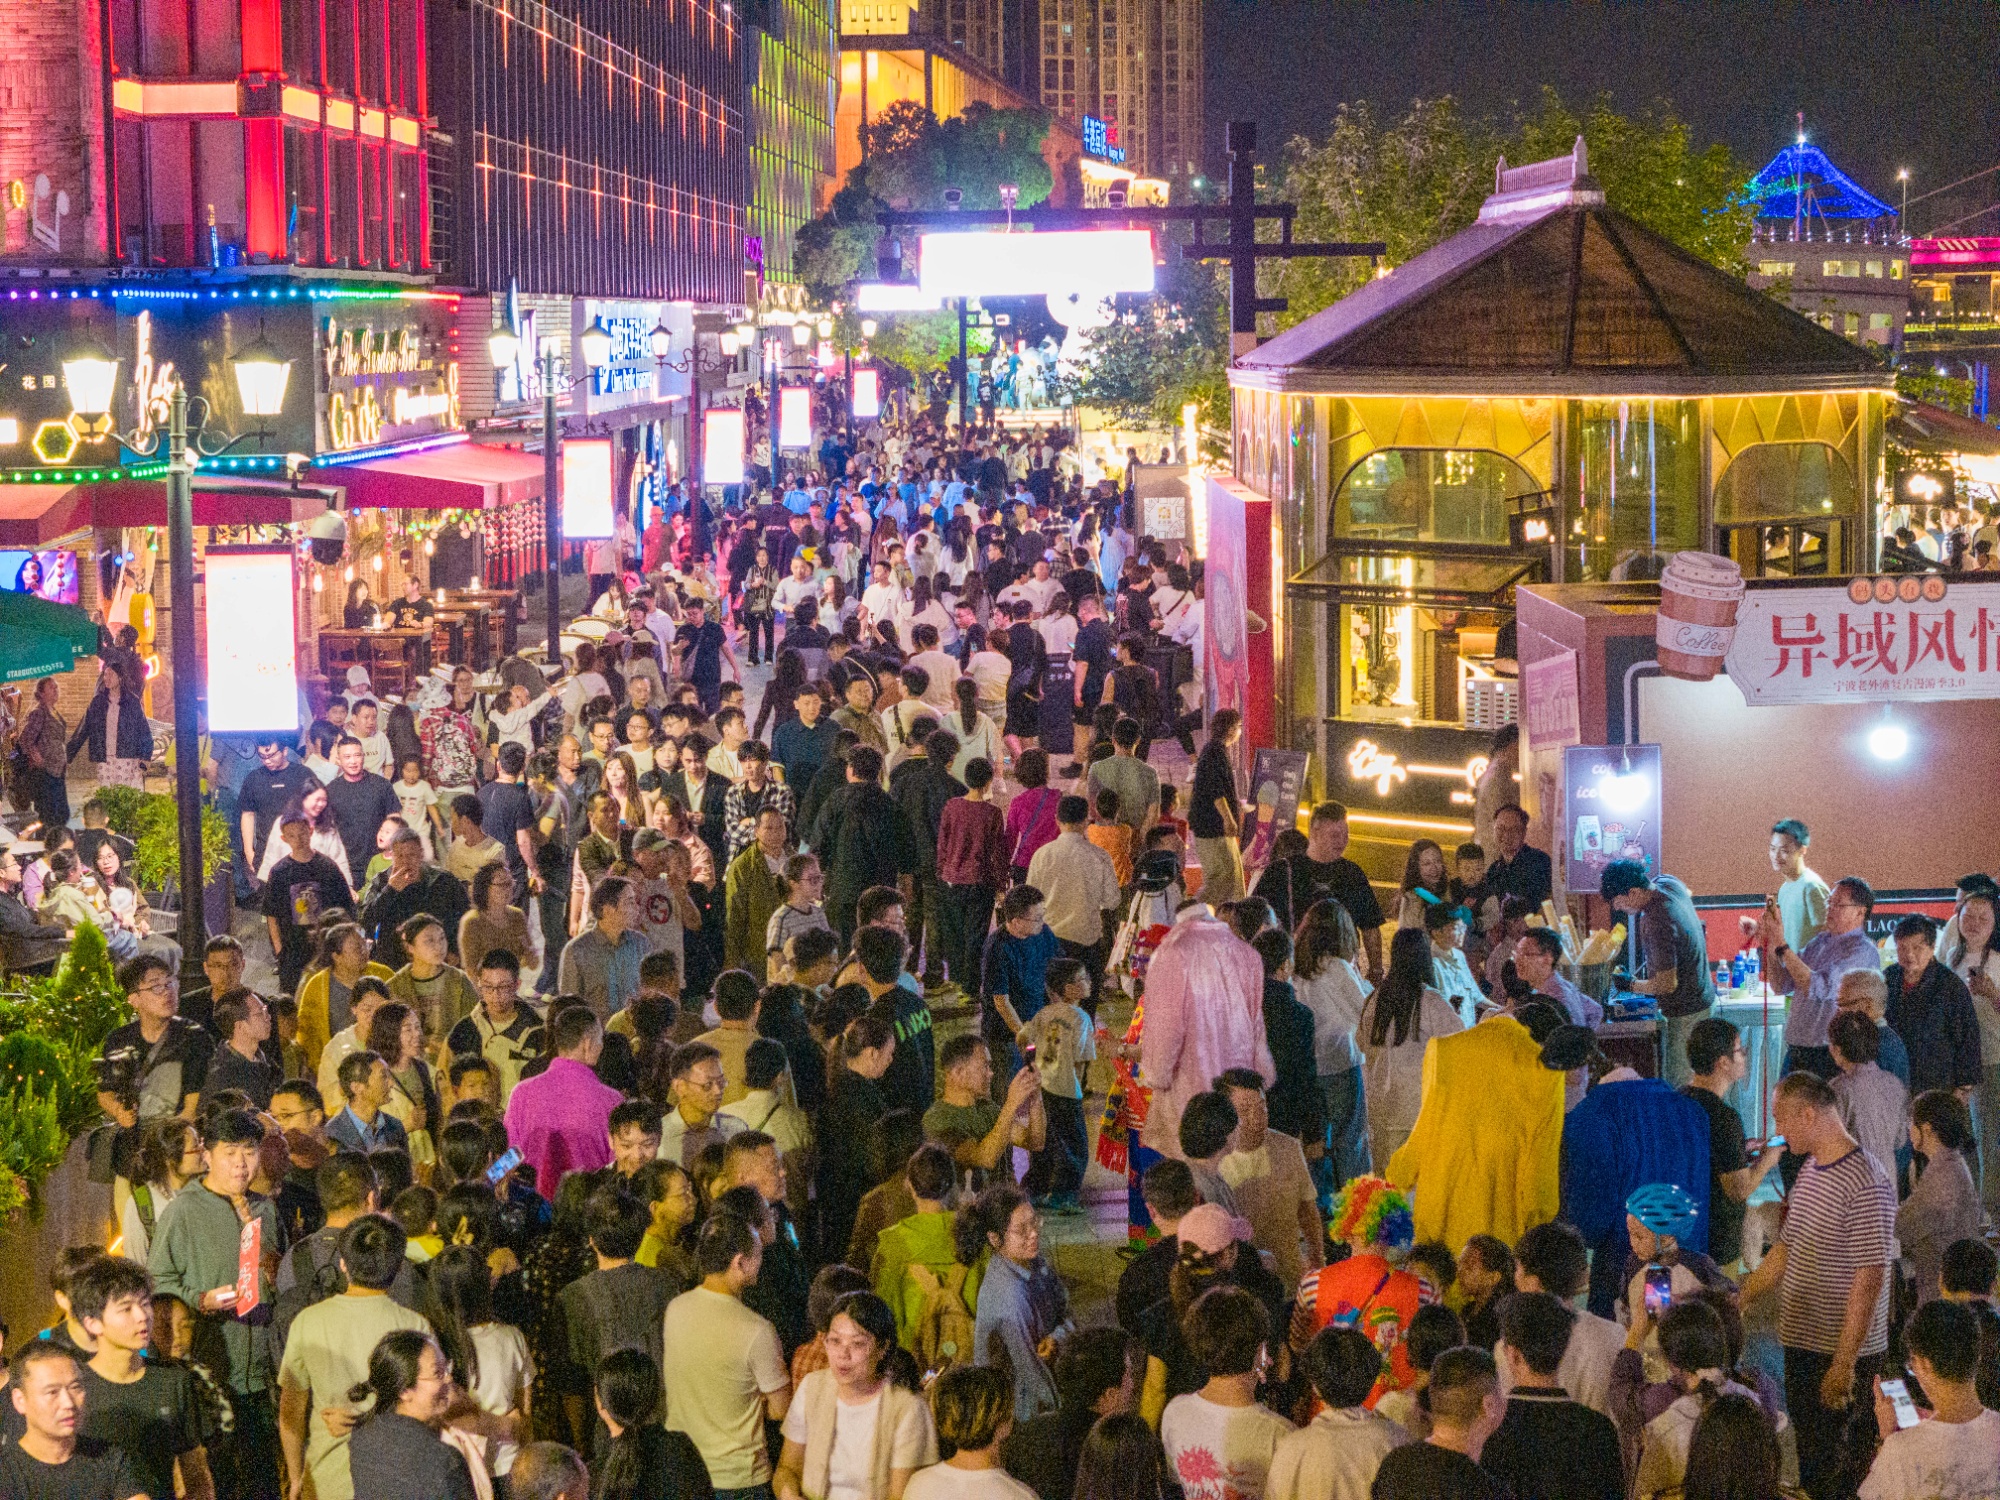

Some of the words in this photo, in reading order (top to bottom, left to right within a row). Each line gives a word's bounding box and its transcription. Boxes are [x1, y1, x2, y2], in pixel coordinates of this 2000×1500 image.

[340, 330, 360, 376] The
[361, 328, 398, 374] Garden
[398, 330, 420, 373] Bar
[1675, 626, 1726, 652] Coffee
[6, 665, 42, 679] STARBUCKS
[1575, 785, 1599, 799] ice
